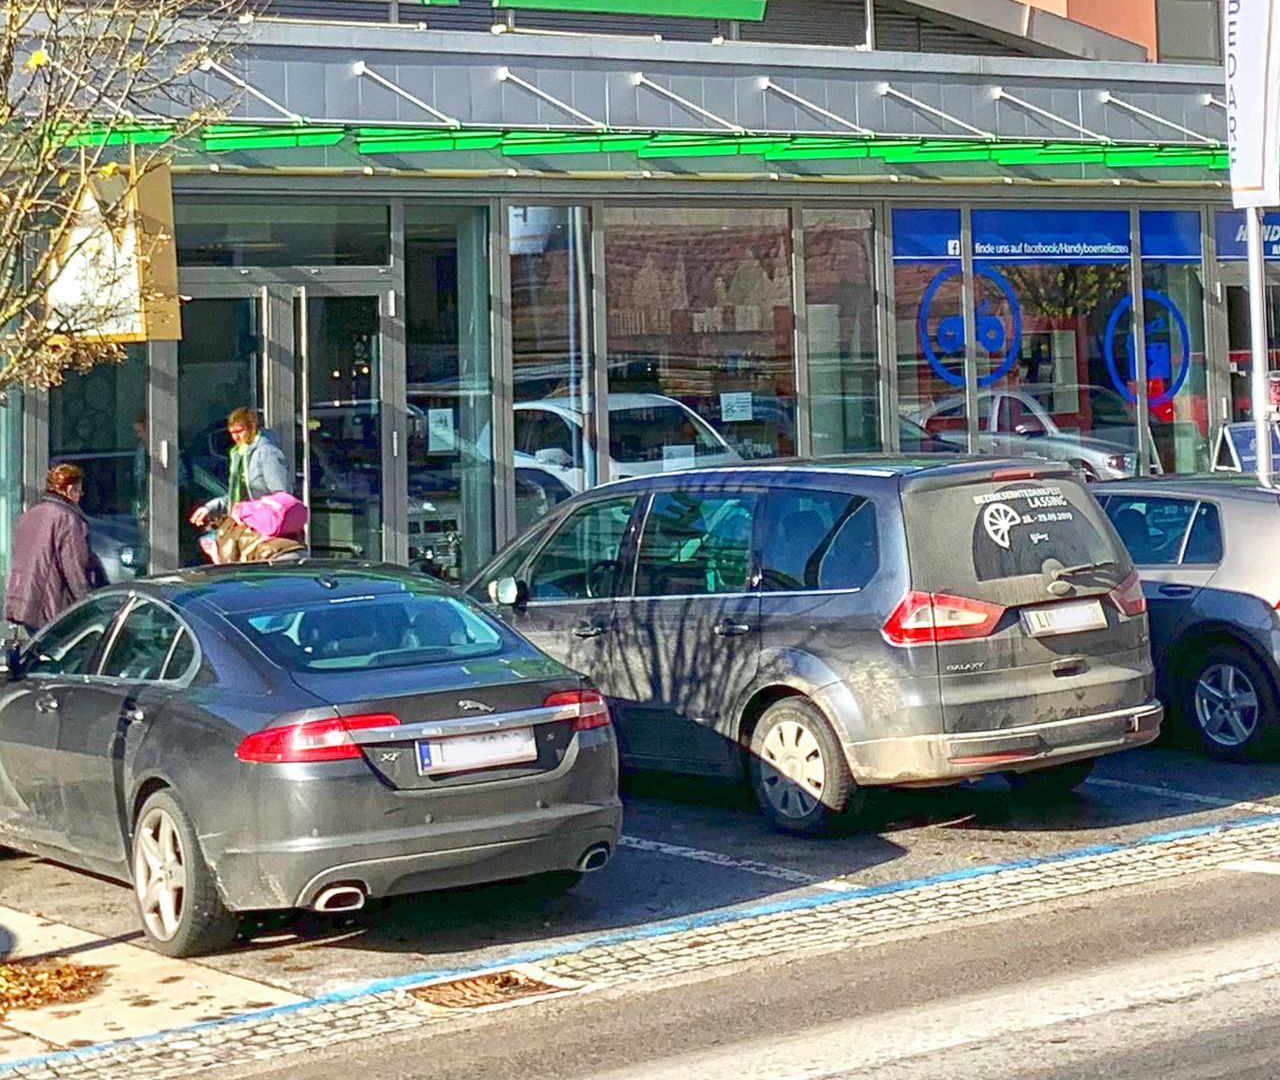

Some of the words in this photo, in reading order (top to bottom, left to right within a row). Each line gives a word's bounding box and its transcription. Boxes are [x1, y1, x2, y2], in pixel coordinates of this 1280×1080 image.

[975, 242, 995, 254] finde
[995, 244, 1009, 254] uns
[1010, 243, 1023, 254] auf
[1027, 495, 1068, 509] LASSING
[946, 661, 985, 671] GALAXY
[380, 751, 401, 762] XF
